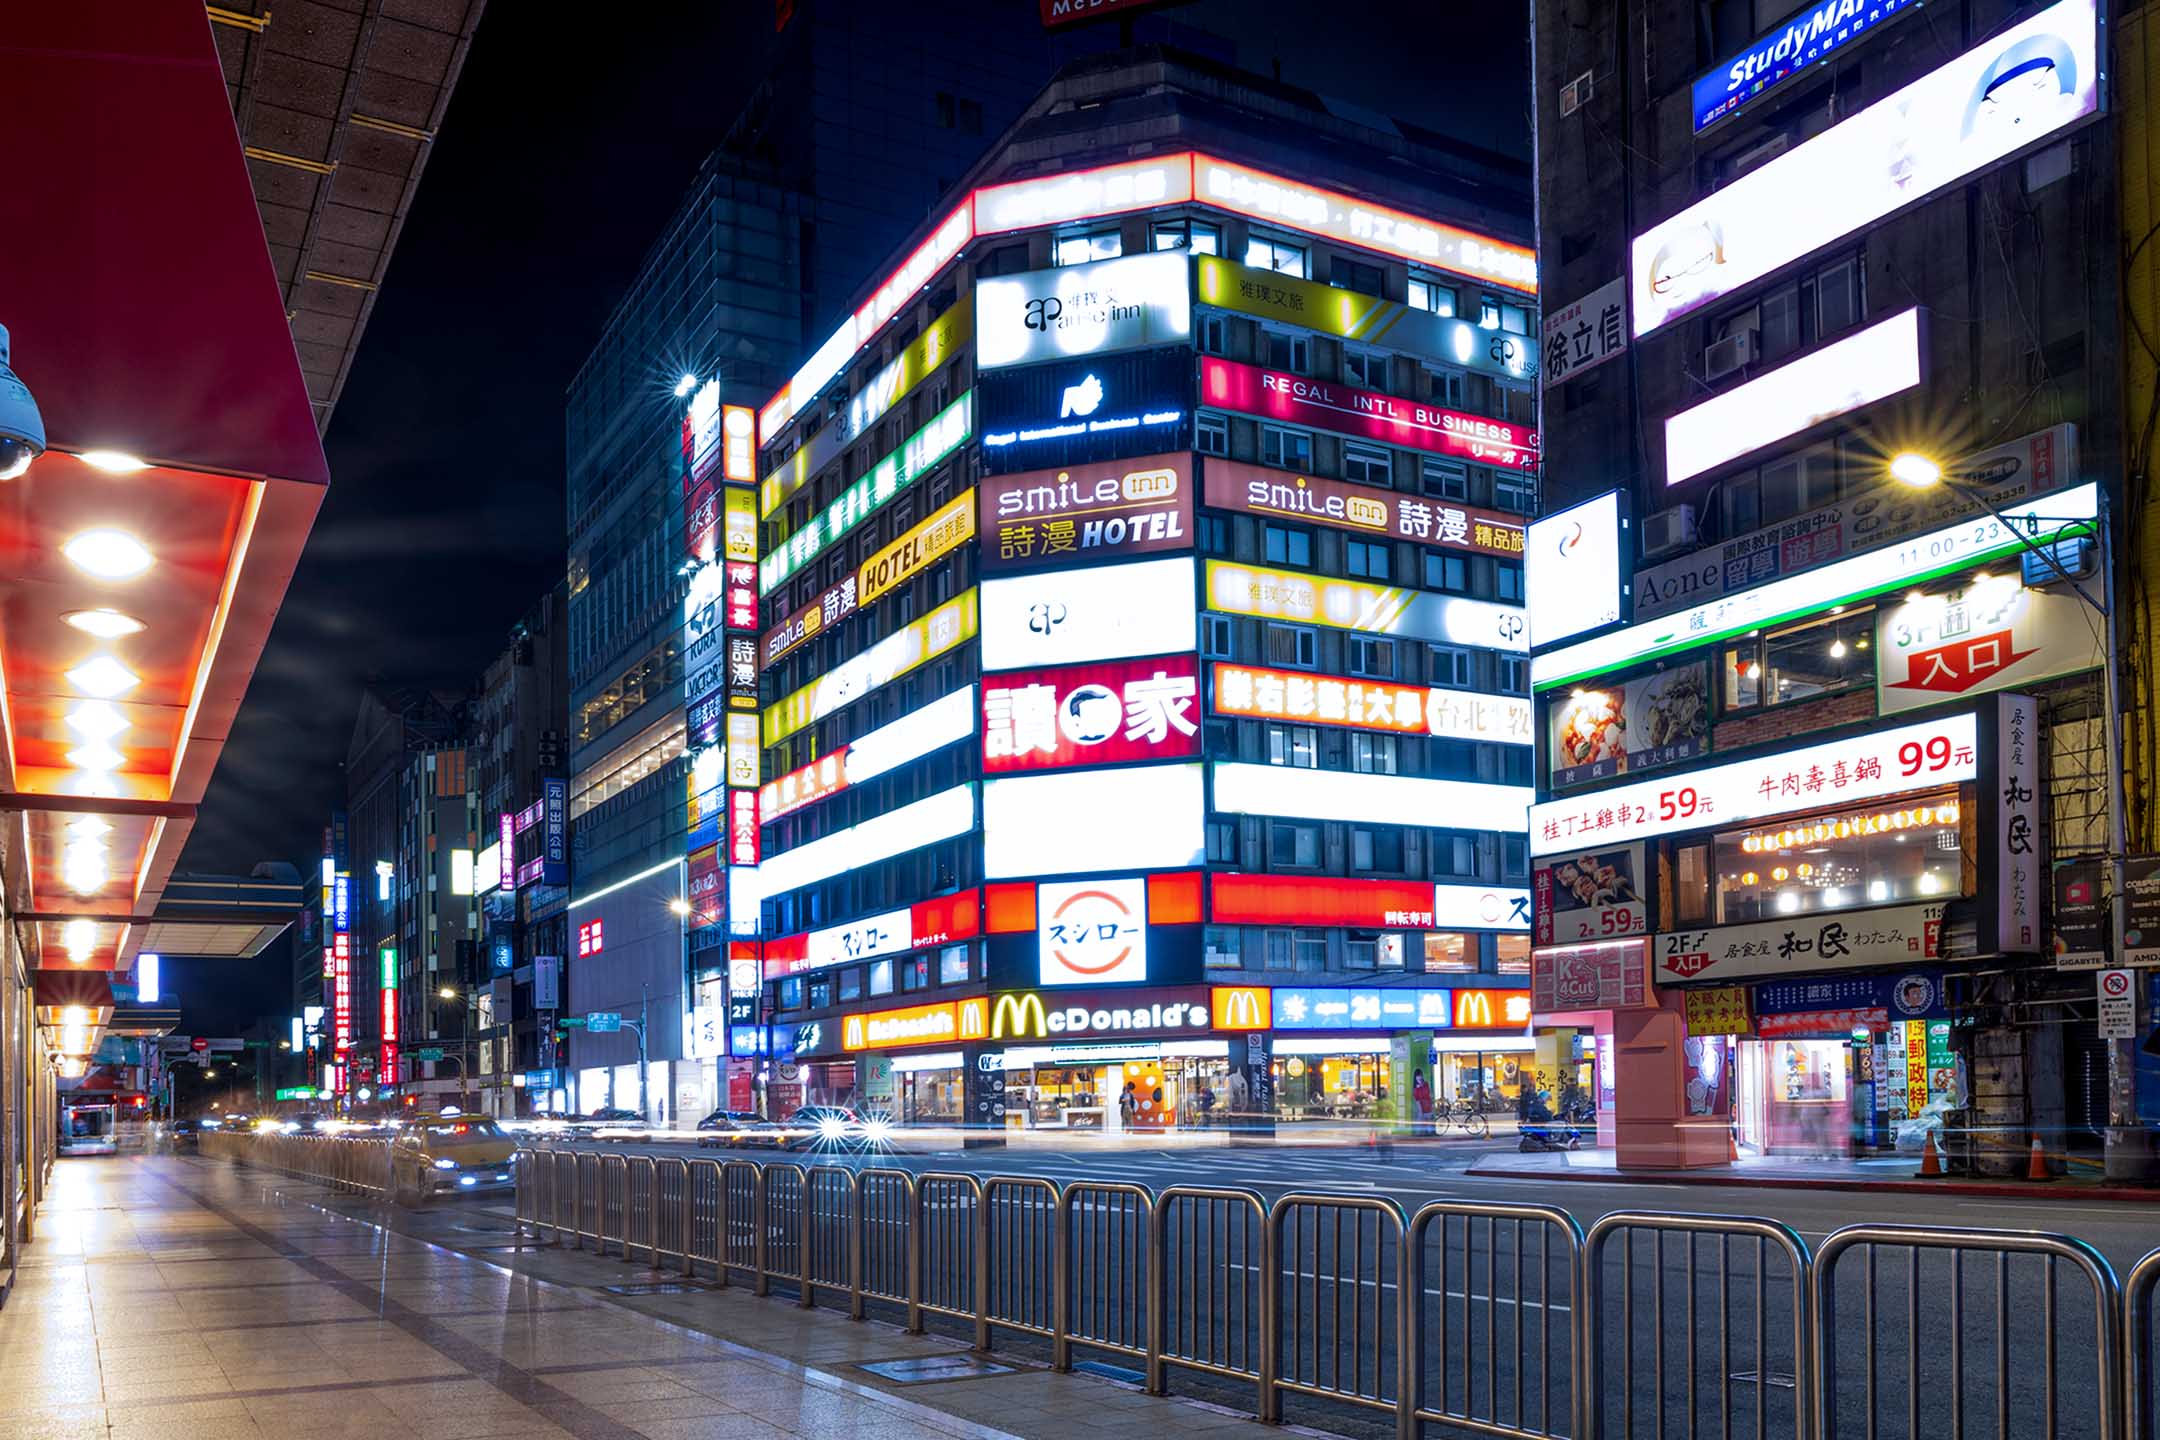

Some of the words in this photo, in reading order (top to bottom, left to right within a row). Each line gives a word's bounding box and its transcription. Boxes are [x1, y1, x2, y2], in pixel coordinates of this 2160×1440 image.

[1728, 0, 1865, 91] StudyMA
[1547, 304, 1621, 381] 徐立信
[1263, 374, 1333, 402] REGAL
[1354, 396, 1397, 417] INTL
[1416, 408, 1512, 440] BUSINESS
[1000, 520, 1077, 560] 詩漫
[1082, 511, 1183, 548] HOTEL
[1398, 500, 1469, 545] 詩漫
[1723, 509, 1843, 560] 國際教育諮詢中心
[864, 538, 921, 597] HOTEL
[1727, 550, 1775, 587] 留學
[1787, 530, 1839, 568] 遊學
[824, 576, 856, 625] 詩漫
[1638, 564, 1719, 609] Aone
[732, 639, 756, 687] 詩漫
[1921, 639, 2000, 686] 入口
[1637, 747, 1689, 767] 義大利麵
[2011, 708, 2025, 766] 居食屋
[1758, 756, 1881, 801] 牛肉壽喜鍋
[1898, 736, 1973, 777] 99元
[2003, 776, 2033, 855] 和民
[2013, 866, 2027, 917] わたみ
[842, 928, 888, 957] スシロー
[1049, 923, 1139, 944] スシロー
[1667, 934, 1690, 954] 2F
[1725, 940, 1771, 959] 居食屋
[1778, 922, 1849, 960] 和民
[1854, 929, 1904, 946] わたみ
[1674, 955, 1702, 972] 入口
[2059, 957, 2101, 967] GIGABYTE
[1559, 980, 1594, 996] 4Cut
[732, 1005, 751, 1018] 2F
[992, 993, 1209, 1039] McDonald's
